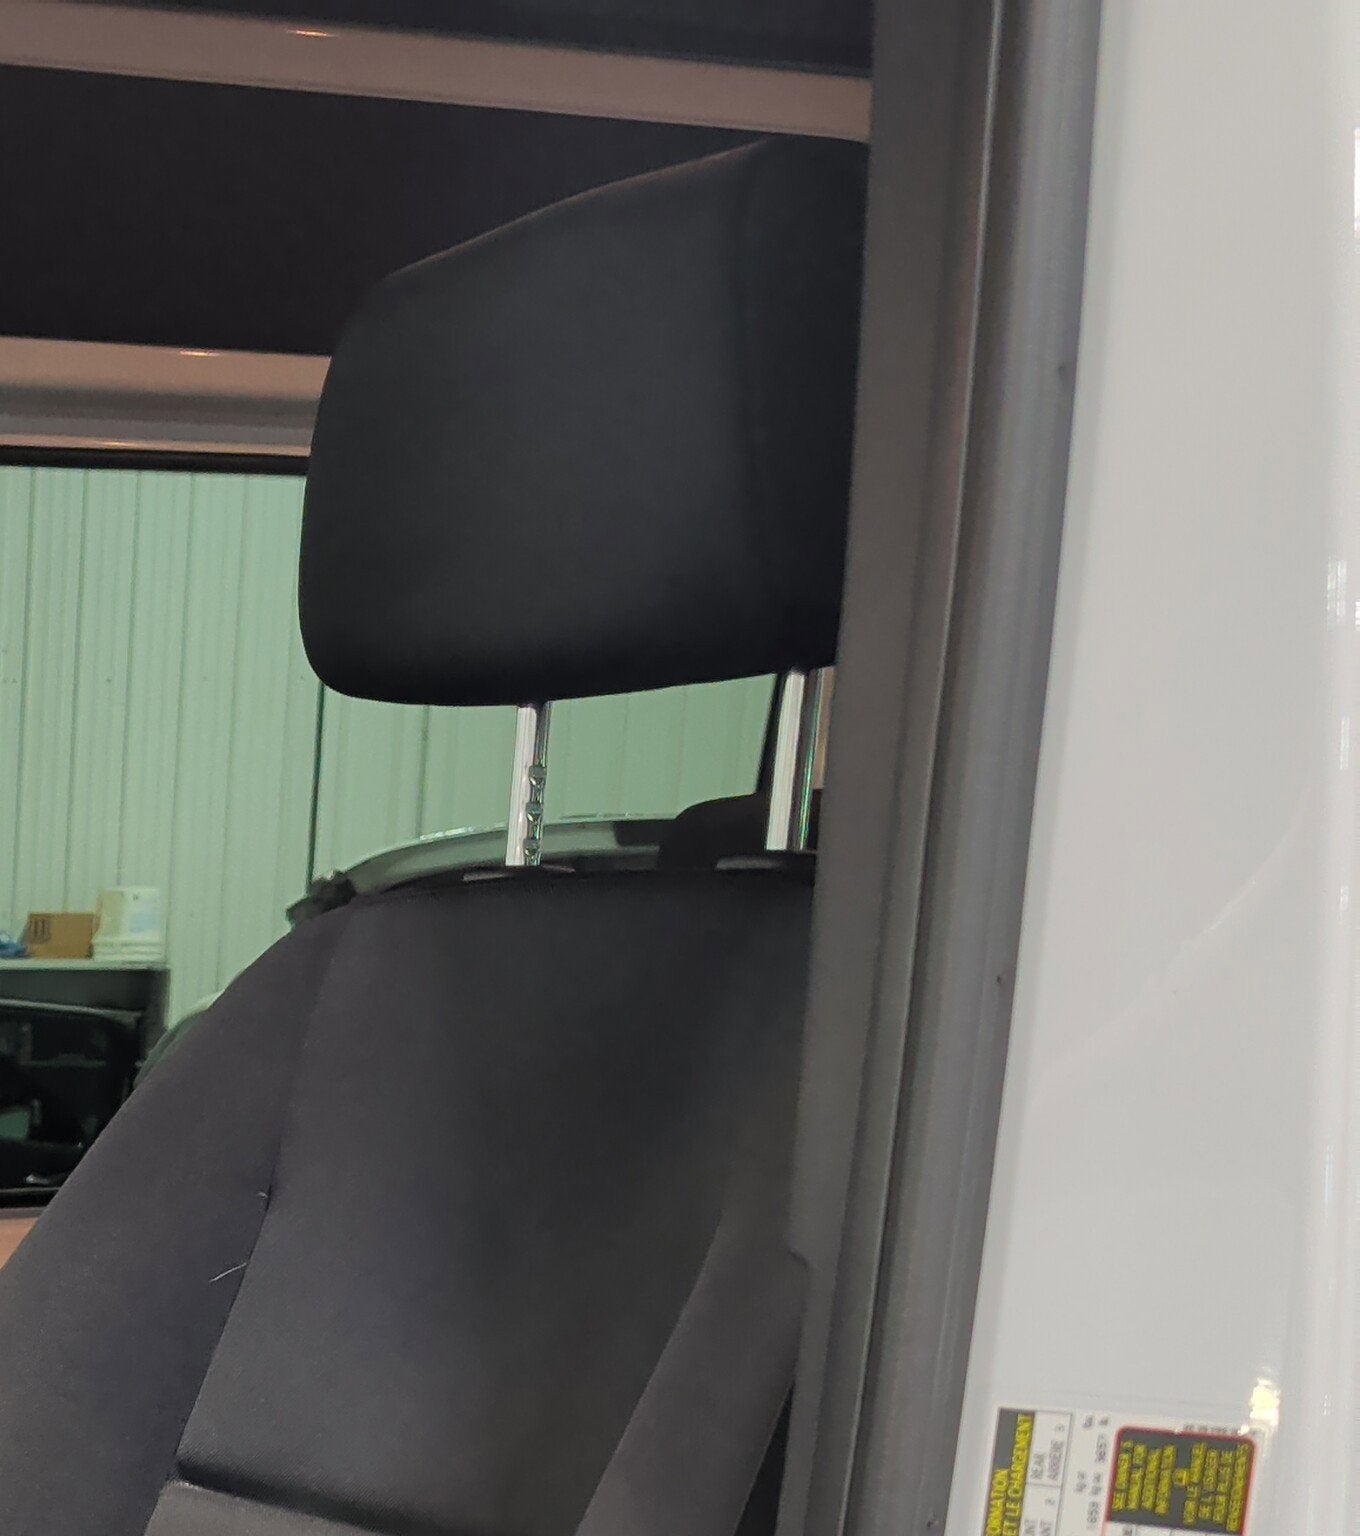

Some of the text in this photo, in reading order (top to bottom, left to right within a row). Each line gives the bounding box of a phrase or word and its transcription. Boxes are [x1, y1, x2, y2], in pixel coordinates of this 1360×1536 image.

[1005, 1413, 1031, 1498] CHARGEMENT
[1029, 1452, 1045, 1479] REAR
[1002, 1500, 1020, 1518] LE
[1000, 1521, 1018, 1536] ET
